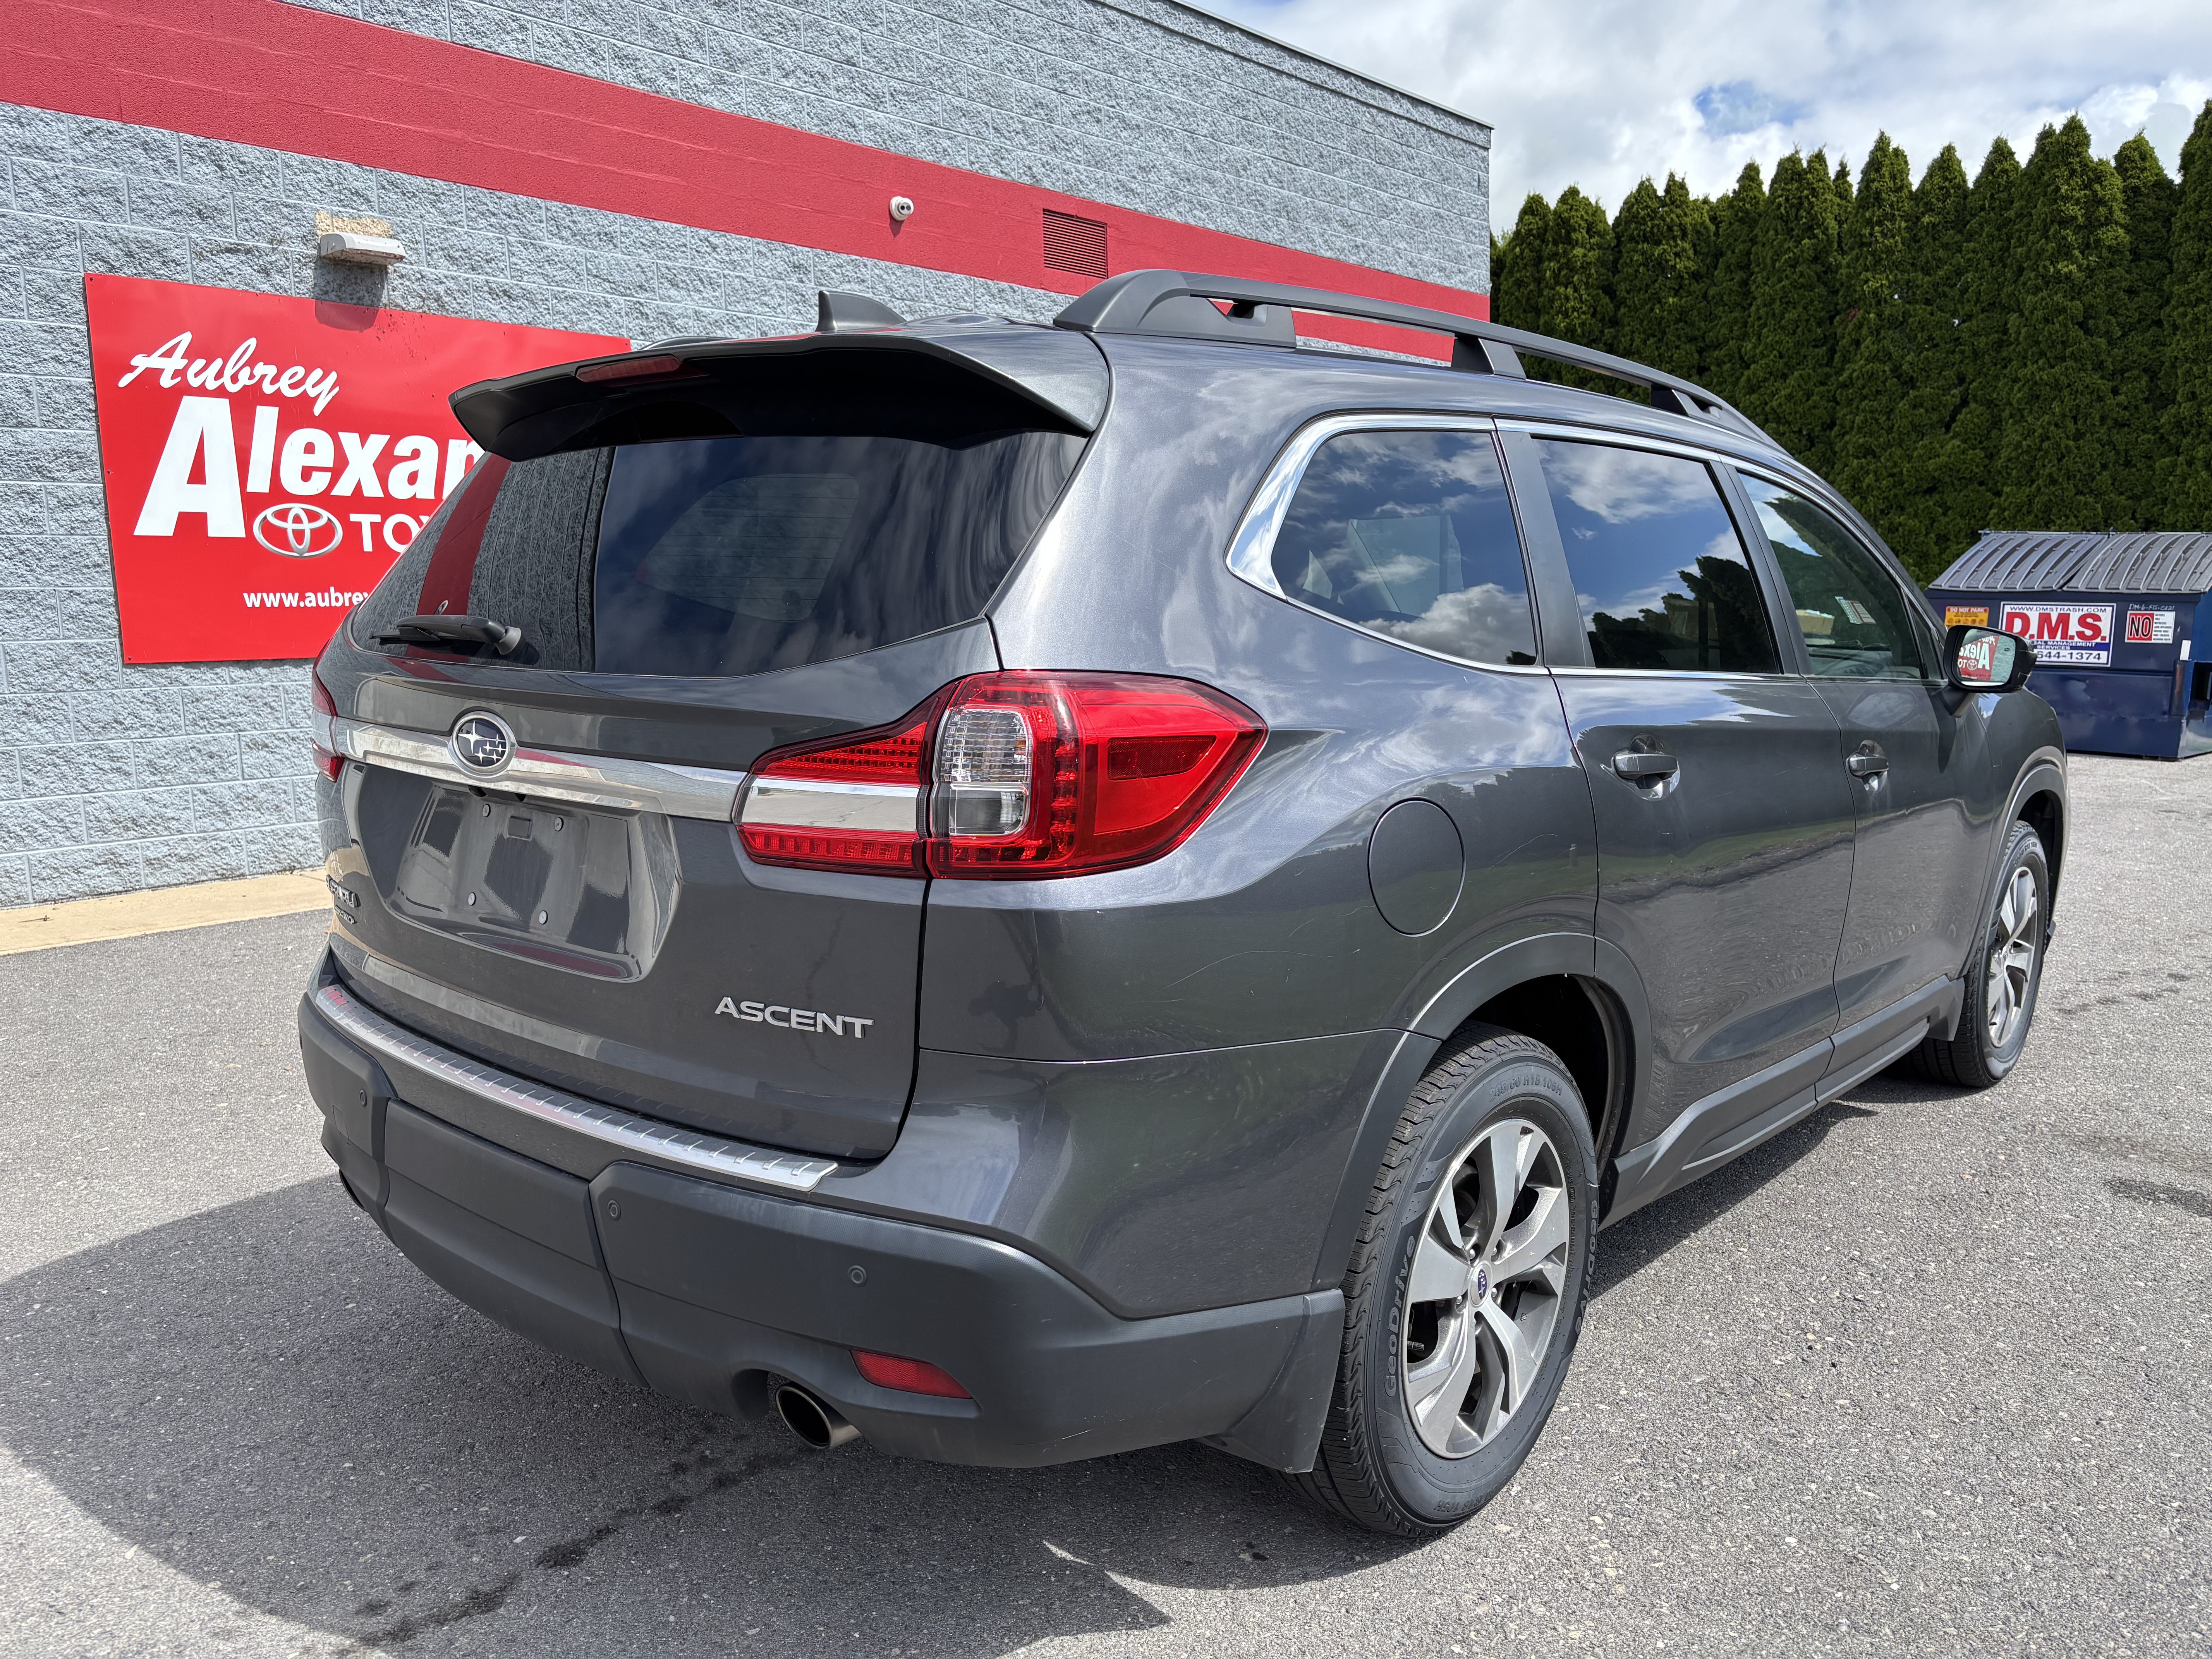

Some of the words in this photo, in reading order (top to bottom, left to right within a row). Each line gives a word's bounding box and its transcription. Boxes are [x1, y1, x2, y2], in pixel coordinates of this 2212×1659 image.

[118, 331, 339, 416] Aubrey
[349, 514, 429, 553] TO
[243, 586, 368, 608] www.aubre
[2129, 615, 2152, 638] NO
[714, 996, 874, 1038] ASCENT
[1523, 1075, 1540, 1085] R18
[1543, 1076, 1563, 1096] 105H
